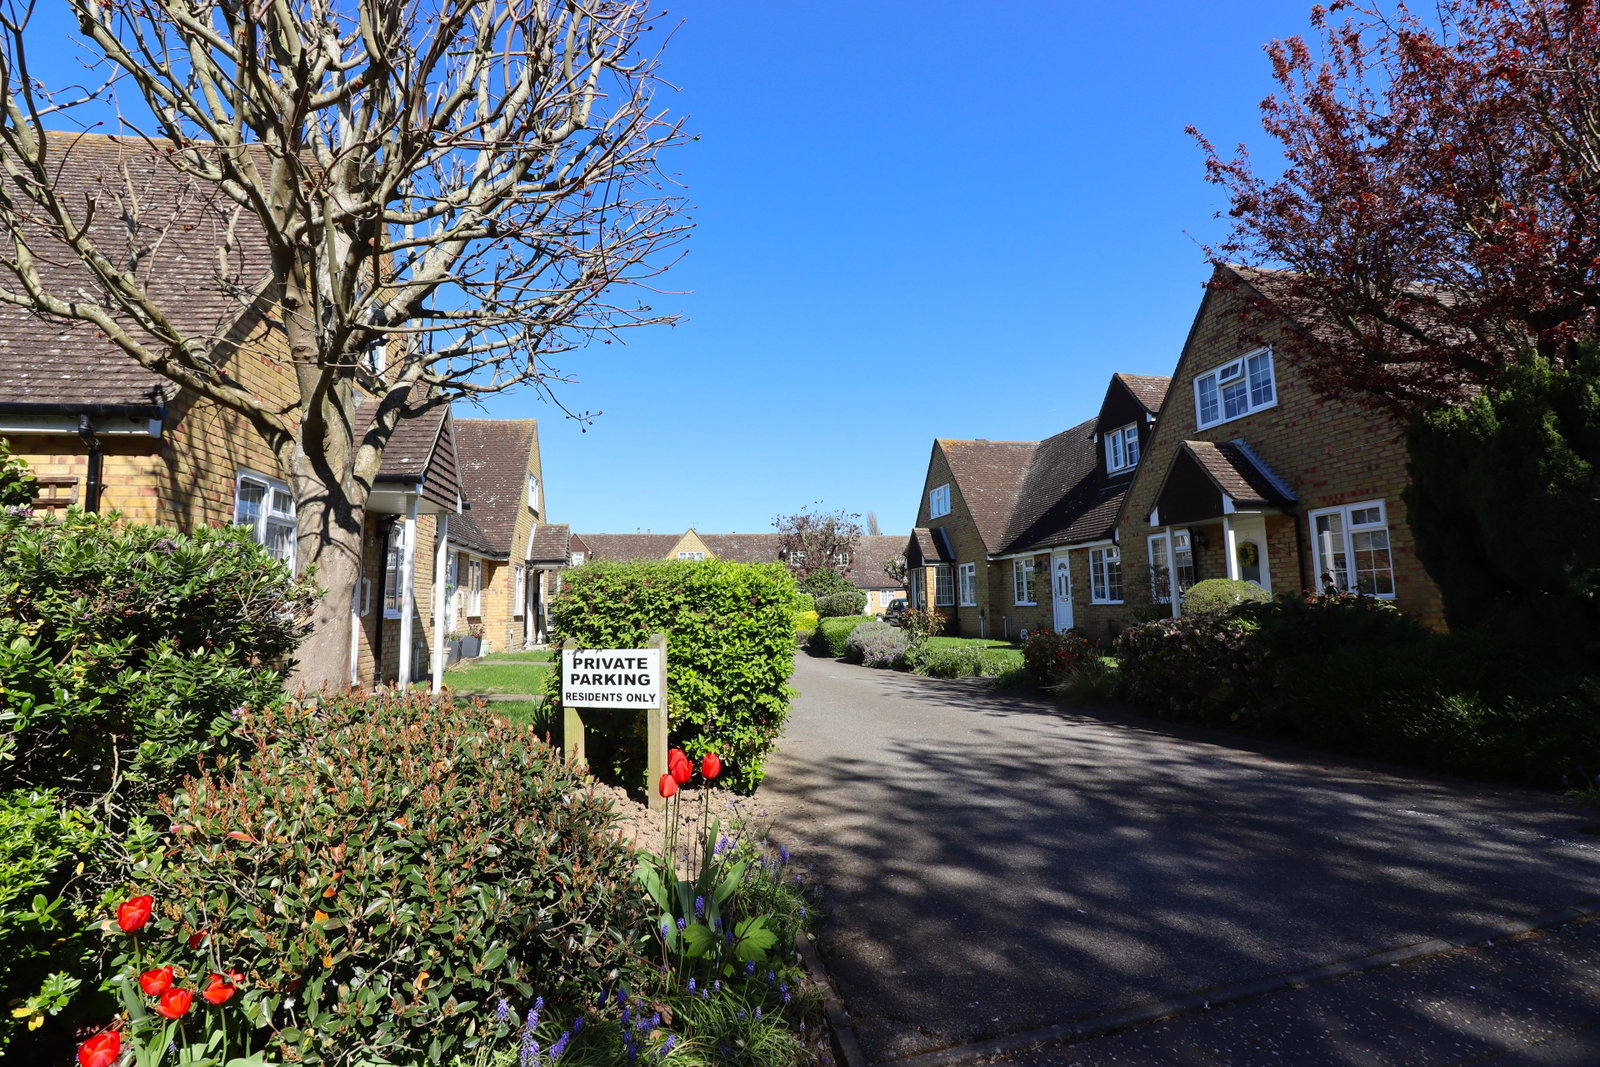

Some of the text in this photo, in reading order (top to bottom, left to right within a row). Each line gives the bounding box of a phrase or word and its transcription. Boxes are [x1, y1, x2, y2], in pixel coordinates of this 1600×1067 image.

[572, 657, 648, 669] PRIVATE
[570, 673, 651, 686] PARKING
[565, 692, 656, 702] RESIDENTS ONLY
